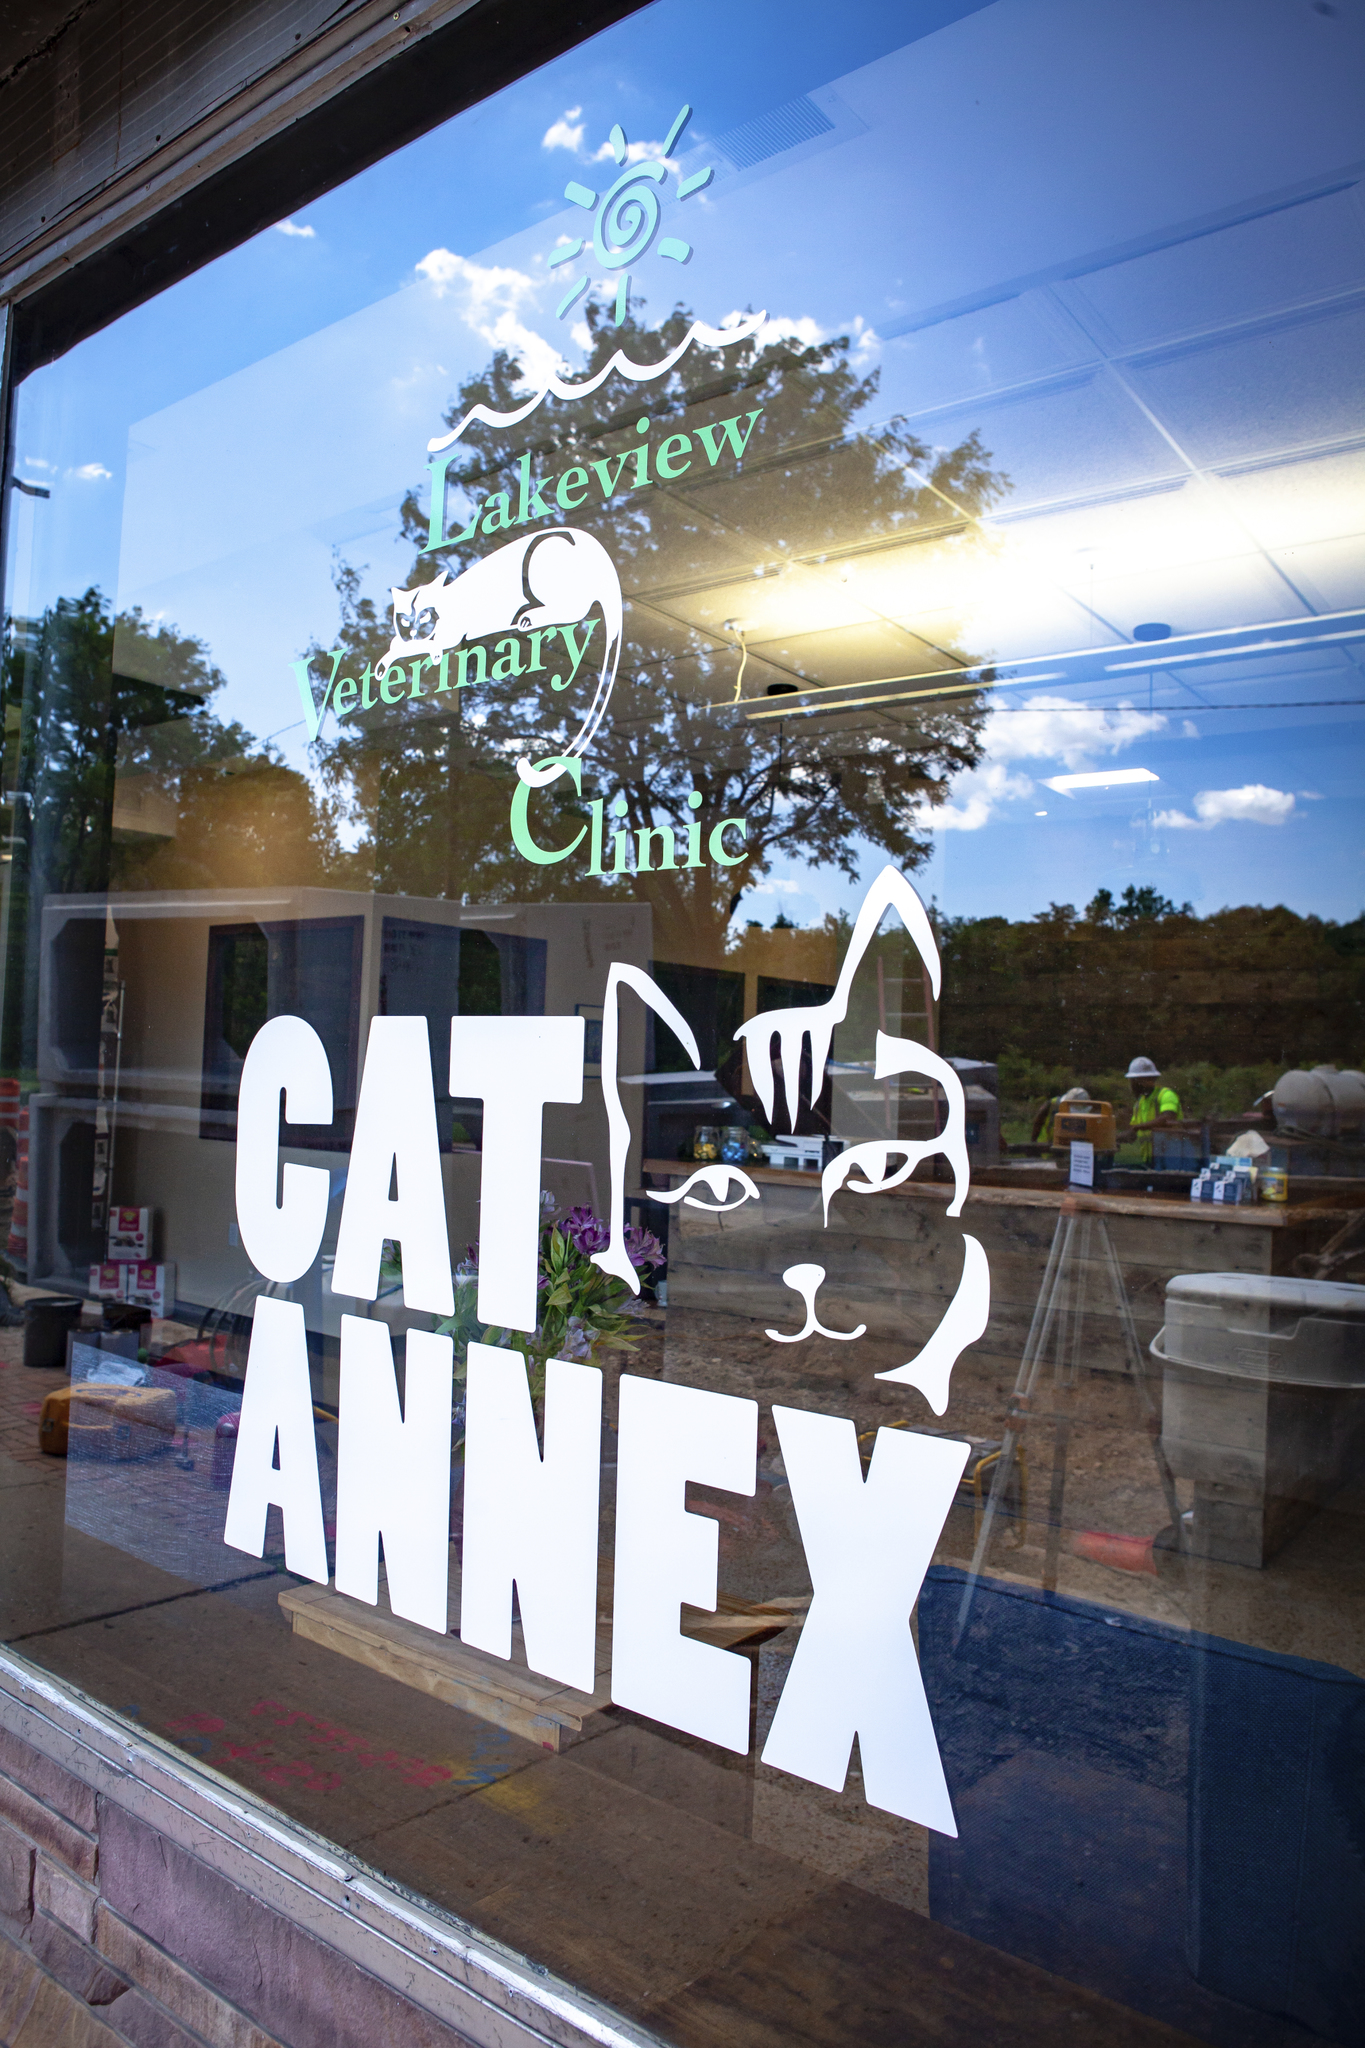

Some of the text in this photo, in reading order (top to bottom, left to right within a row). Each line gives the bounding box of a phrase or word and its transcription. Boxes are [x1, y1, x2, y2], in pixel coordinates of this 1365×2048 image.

[418, 408, 764, 555] Lakeview
[288, 618, 602, 742] Veterinary
[510, 756, 750, 877] Clinic
[235, 1015, 586, 1333] CAT
[223, 1295, 972, 1839] ANNEX
